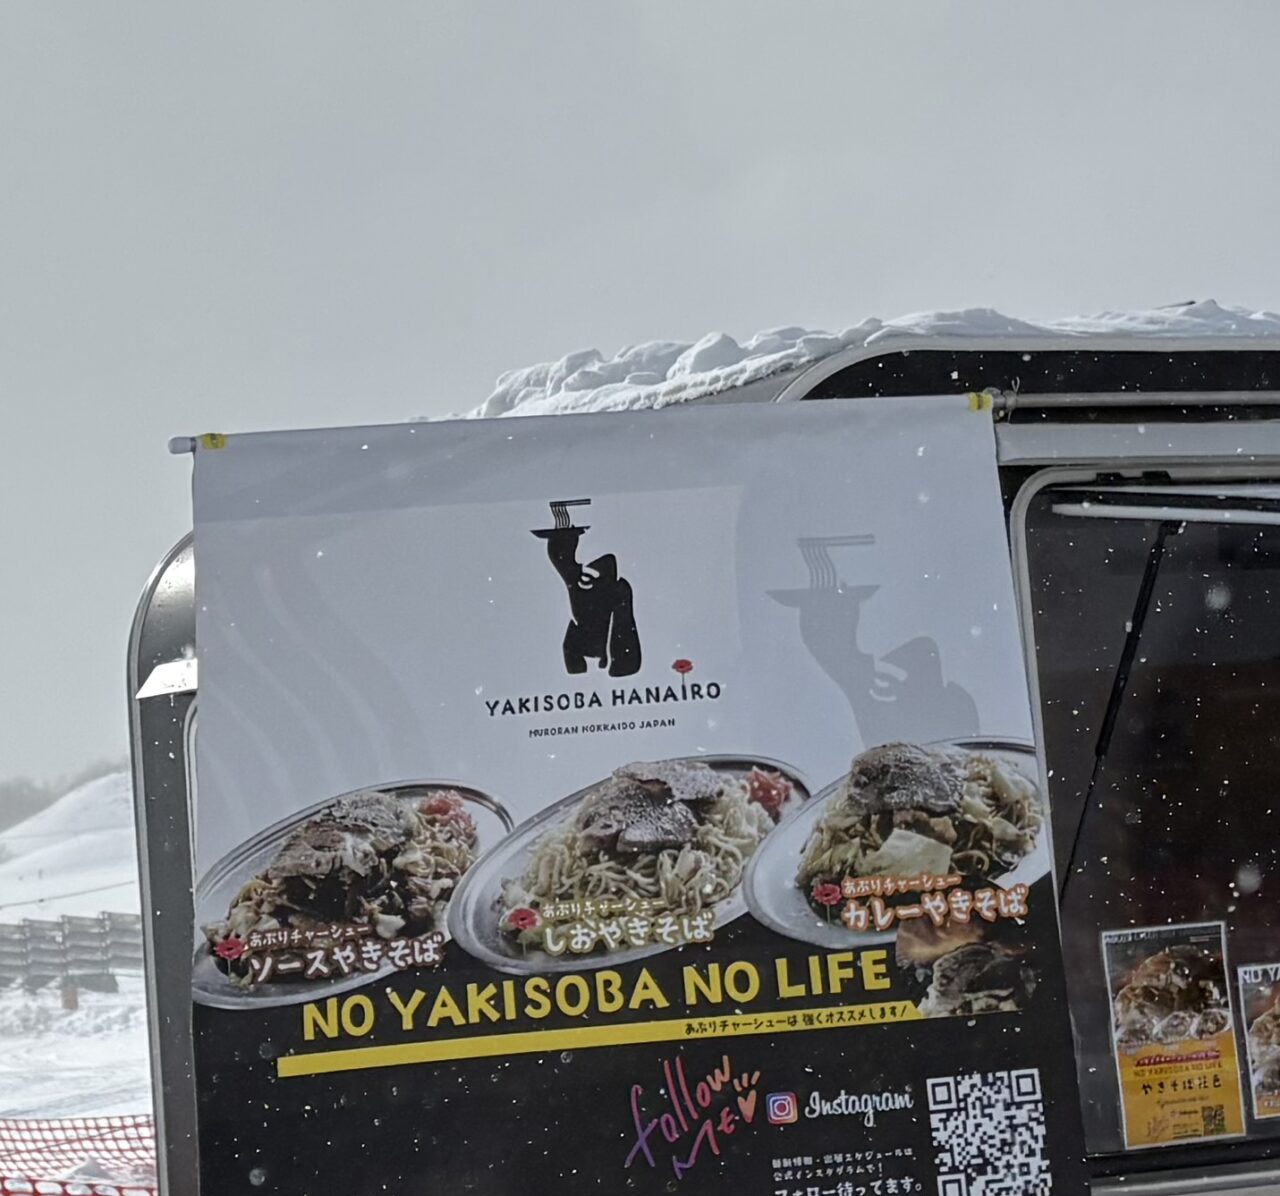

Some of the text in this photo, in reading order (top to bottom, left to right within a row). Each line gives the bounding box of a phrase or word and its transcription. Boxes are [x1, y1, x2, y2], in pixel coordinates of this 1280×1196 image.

[485, 682, 721, 716] YAKISOBA HANAIRO
[529, 718, 675, 738] MURORAN HOKKAIDO JAPAN
[844, 876, 960, 894] あぶりチャーシュー
[844, 887, 1026, 928] カレーやきそば
[250, 925, 369, 947] あぶりチャーシュー
[545, 912, 713, 952] しおやきそば
[252, 934, 443, 982] ソースやきそば
[303, 949, 891, 1040] NO YAKISOBA NO LIFE
[625, 1055, 731, 1168] follow
[804, 1090, 914, 1128] Instagram
